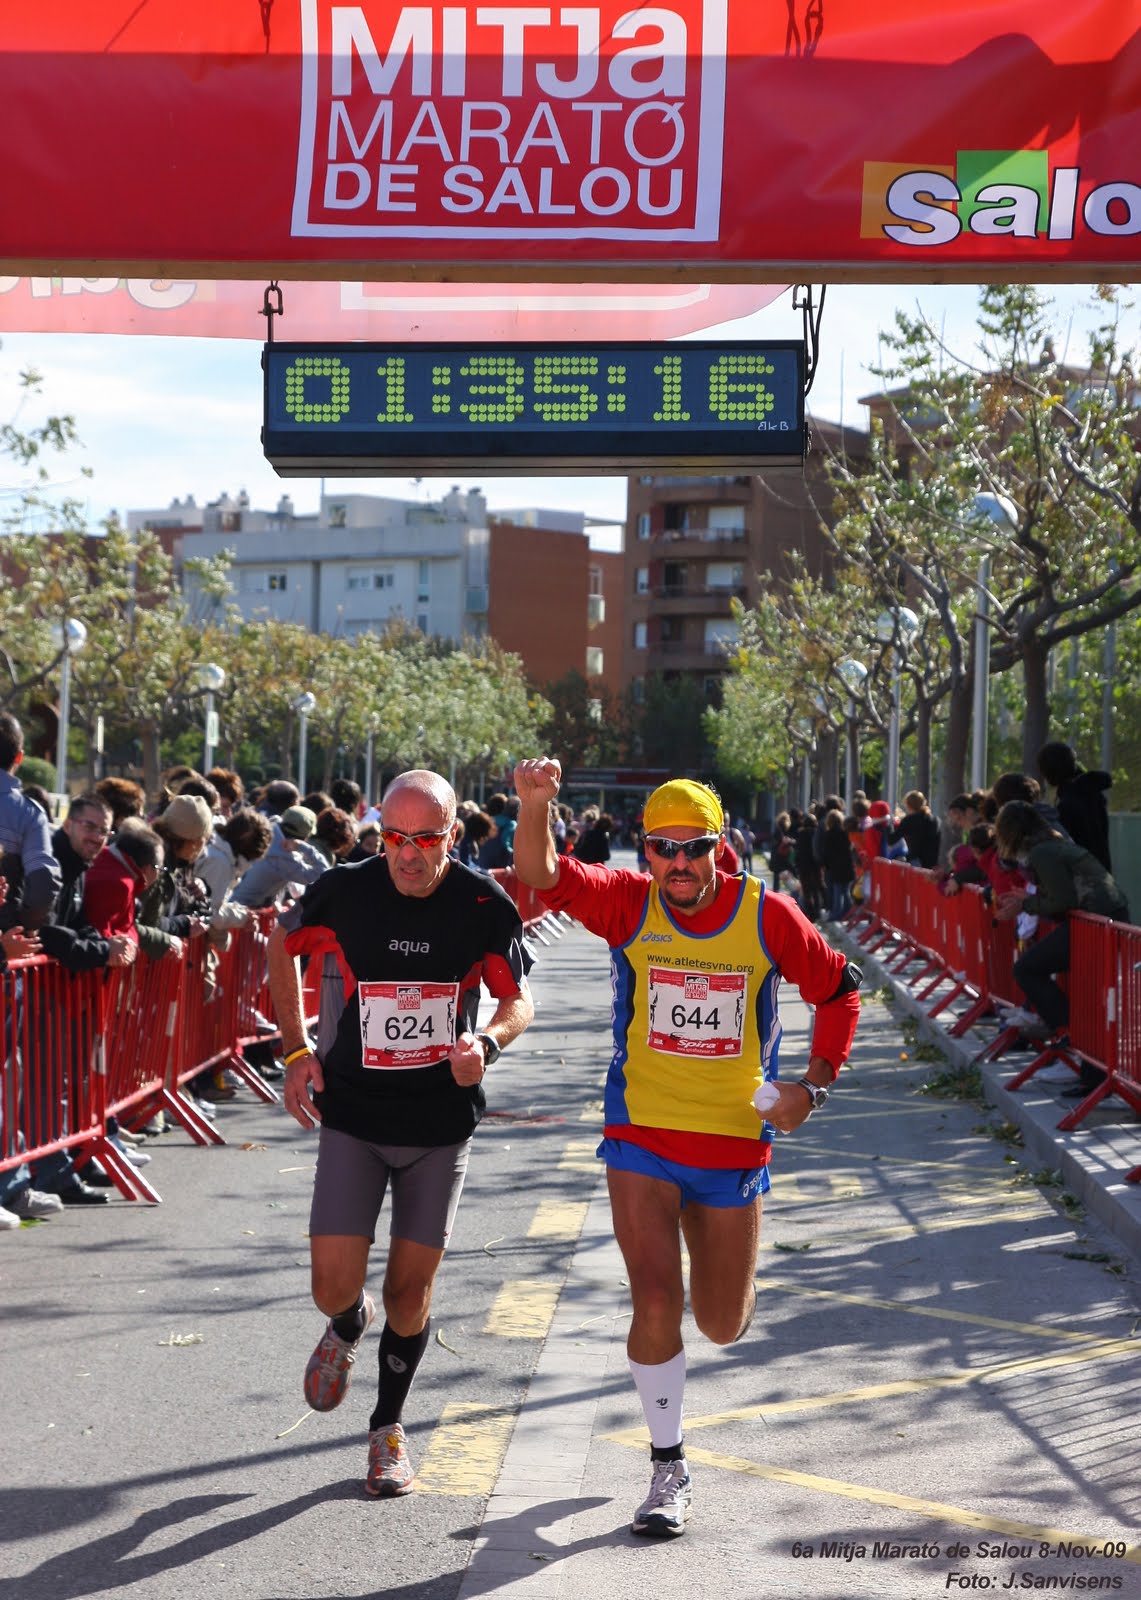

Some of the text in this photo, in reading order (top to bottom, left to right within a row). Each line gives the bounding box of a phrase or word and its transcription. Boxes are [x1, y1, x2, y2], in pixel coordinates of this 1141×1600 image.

[327, 100, 685, 167] MARATÓ
[323, 163, 683, 216] DE SALOU
[285, 356, 775, 422] 01:35:16
[388, 939, 430, 957] aqua
[647, 953, 755, 975] www.atletesvng.org
[384, 1015, 435, 1041] 624
[671, 1004, 721, 1030] 644
[392, 1050, 431, 1060] Spira
[677, 1039, 717, 1049] Spira
